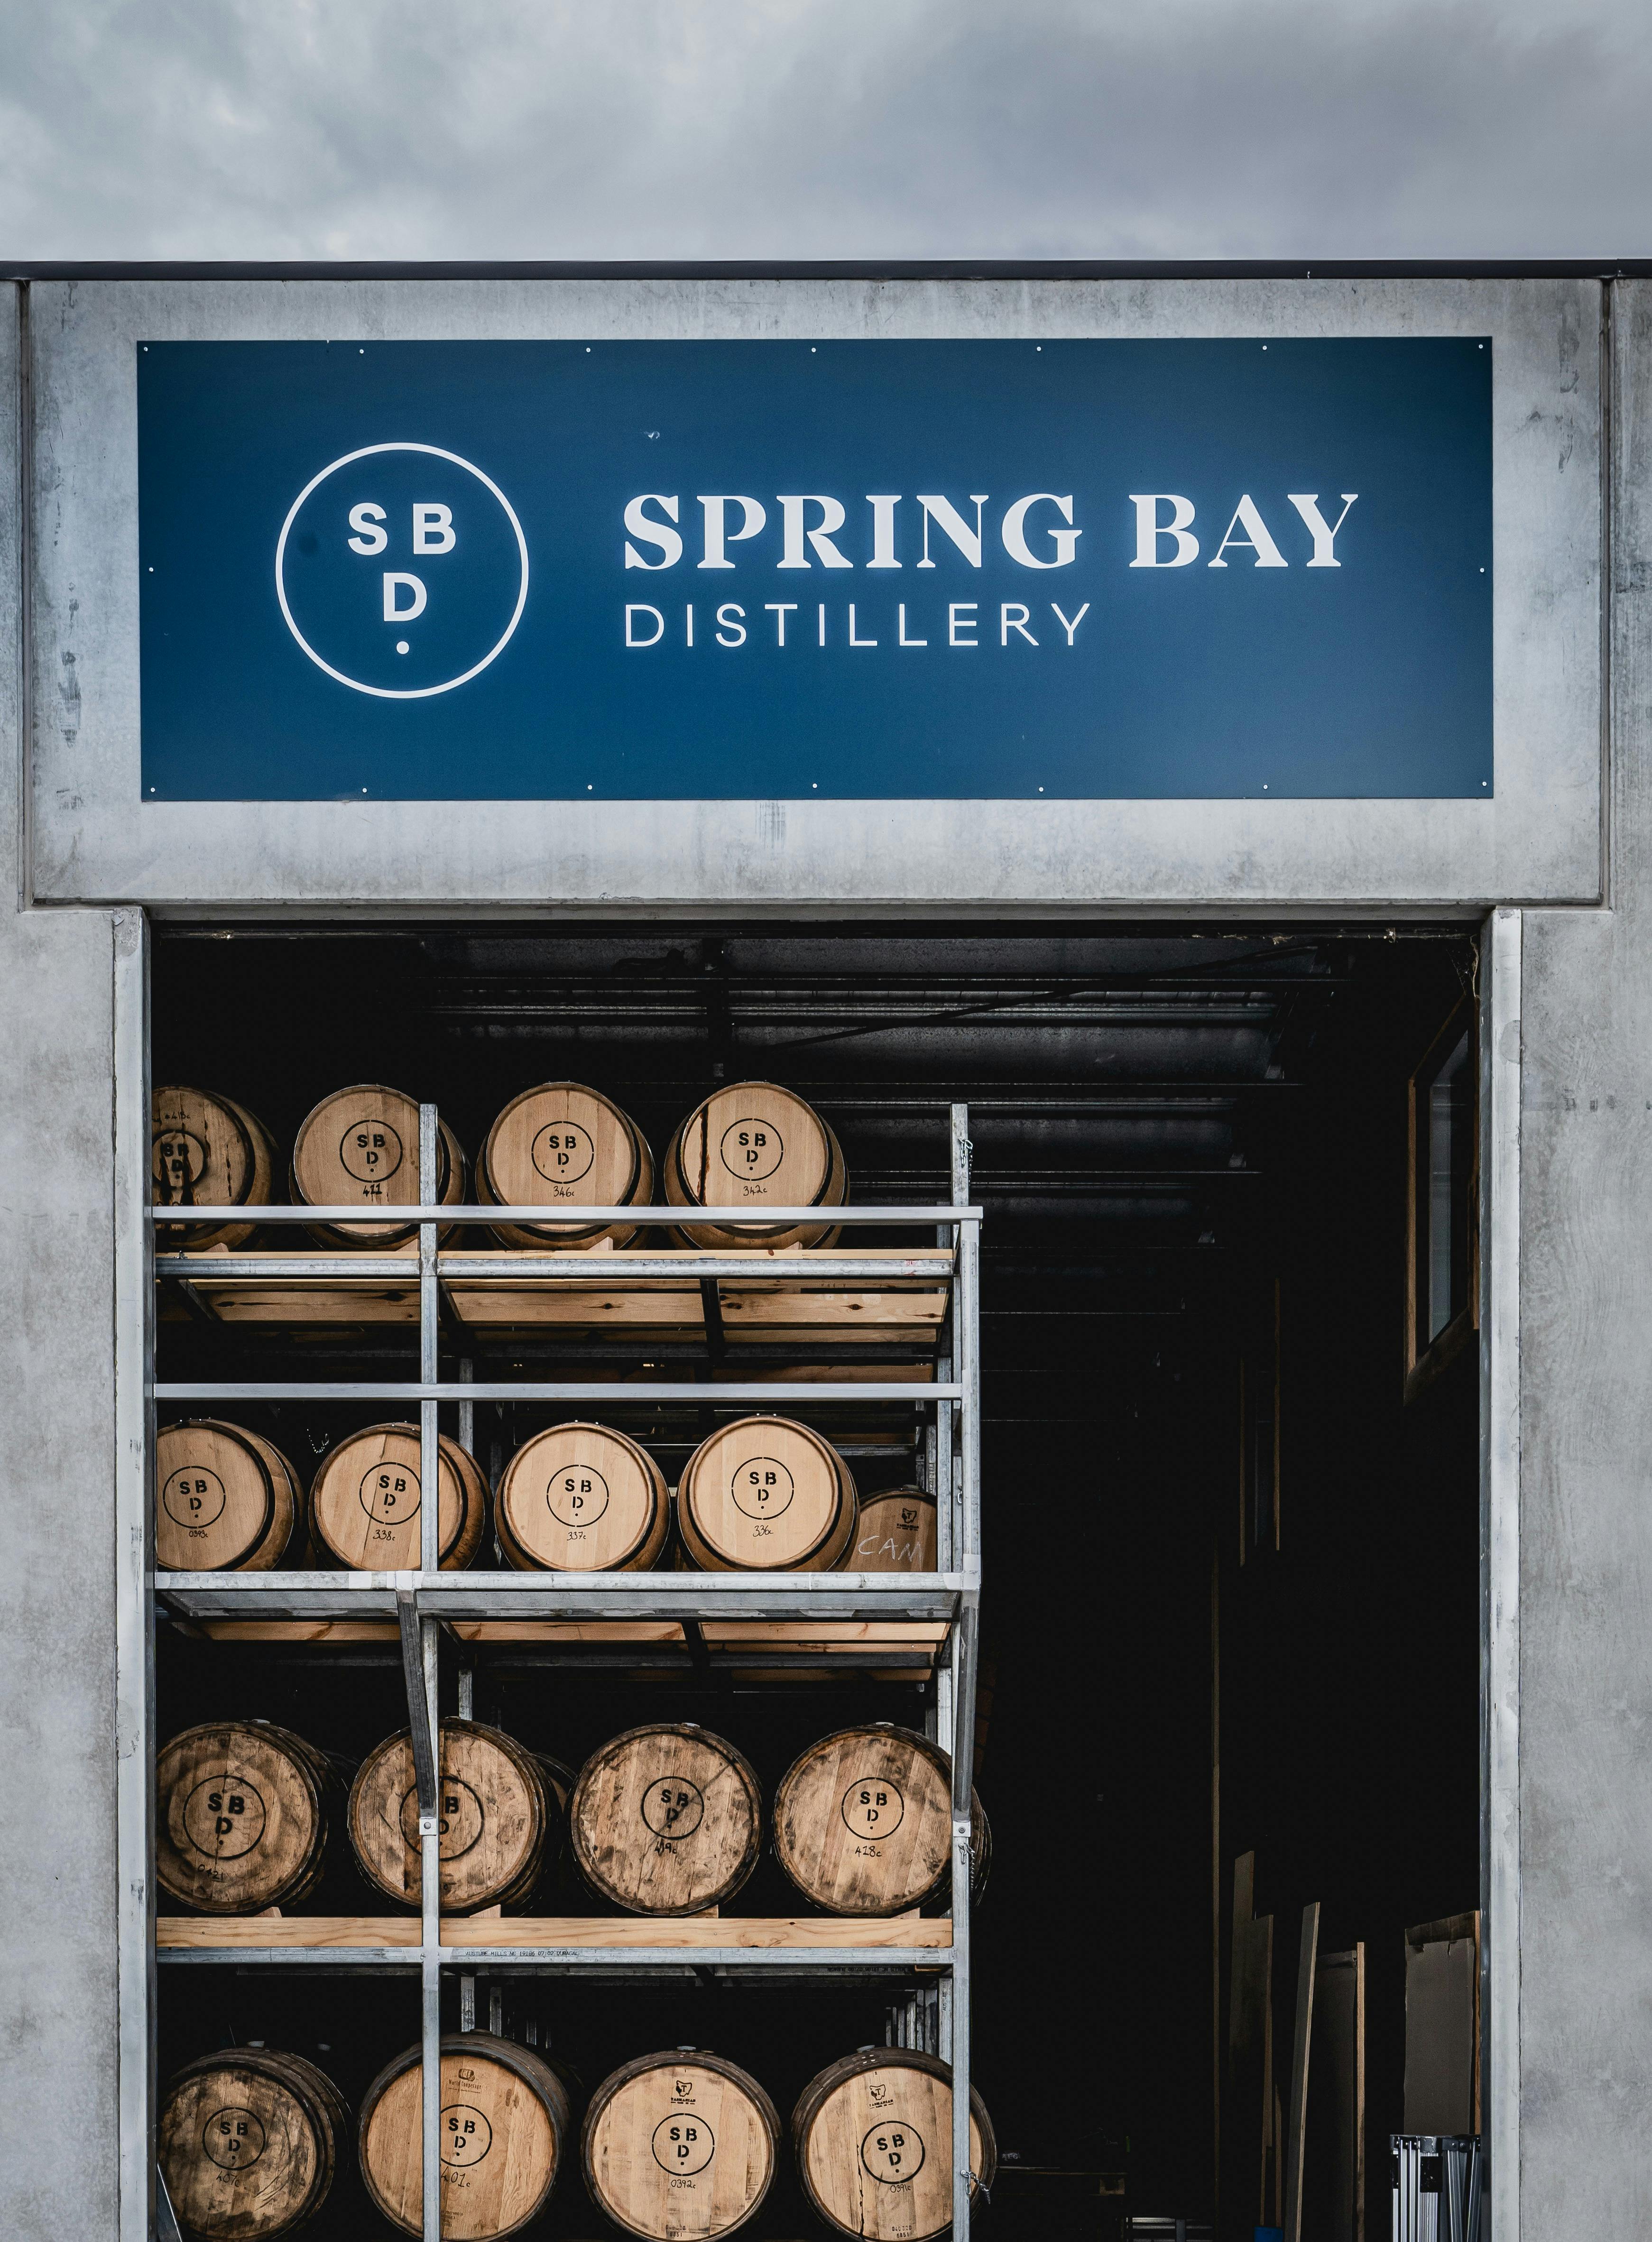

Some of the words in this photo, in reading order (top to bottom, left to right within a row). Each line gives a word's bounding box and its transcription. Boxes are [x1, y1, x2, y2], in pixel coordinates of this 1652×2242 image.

[624, 494, 1083, 570] SPRING
[1129, 494, 1358, 568] BAY
[384, 572, 427, 622] D
[626, 603, 1090, 647] DISTILLERY
